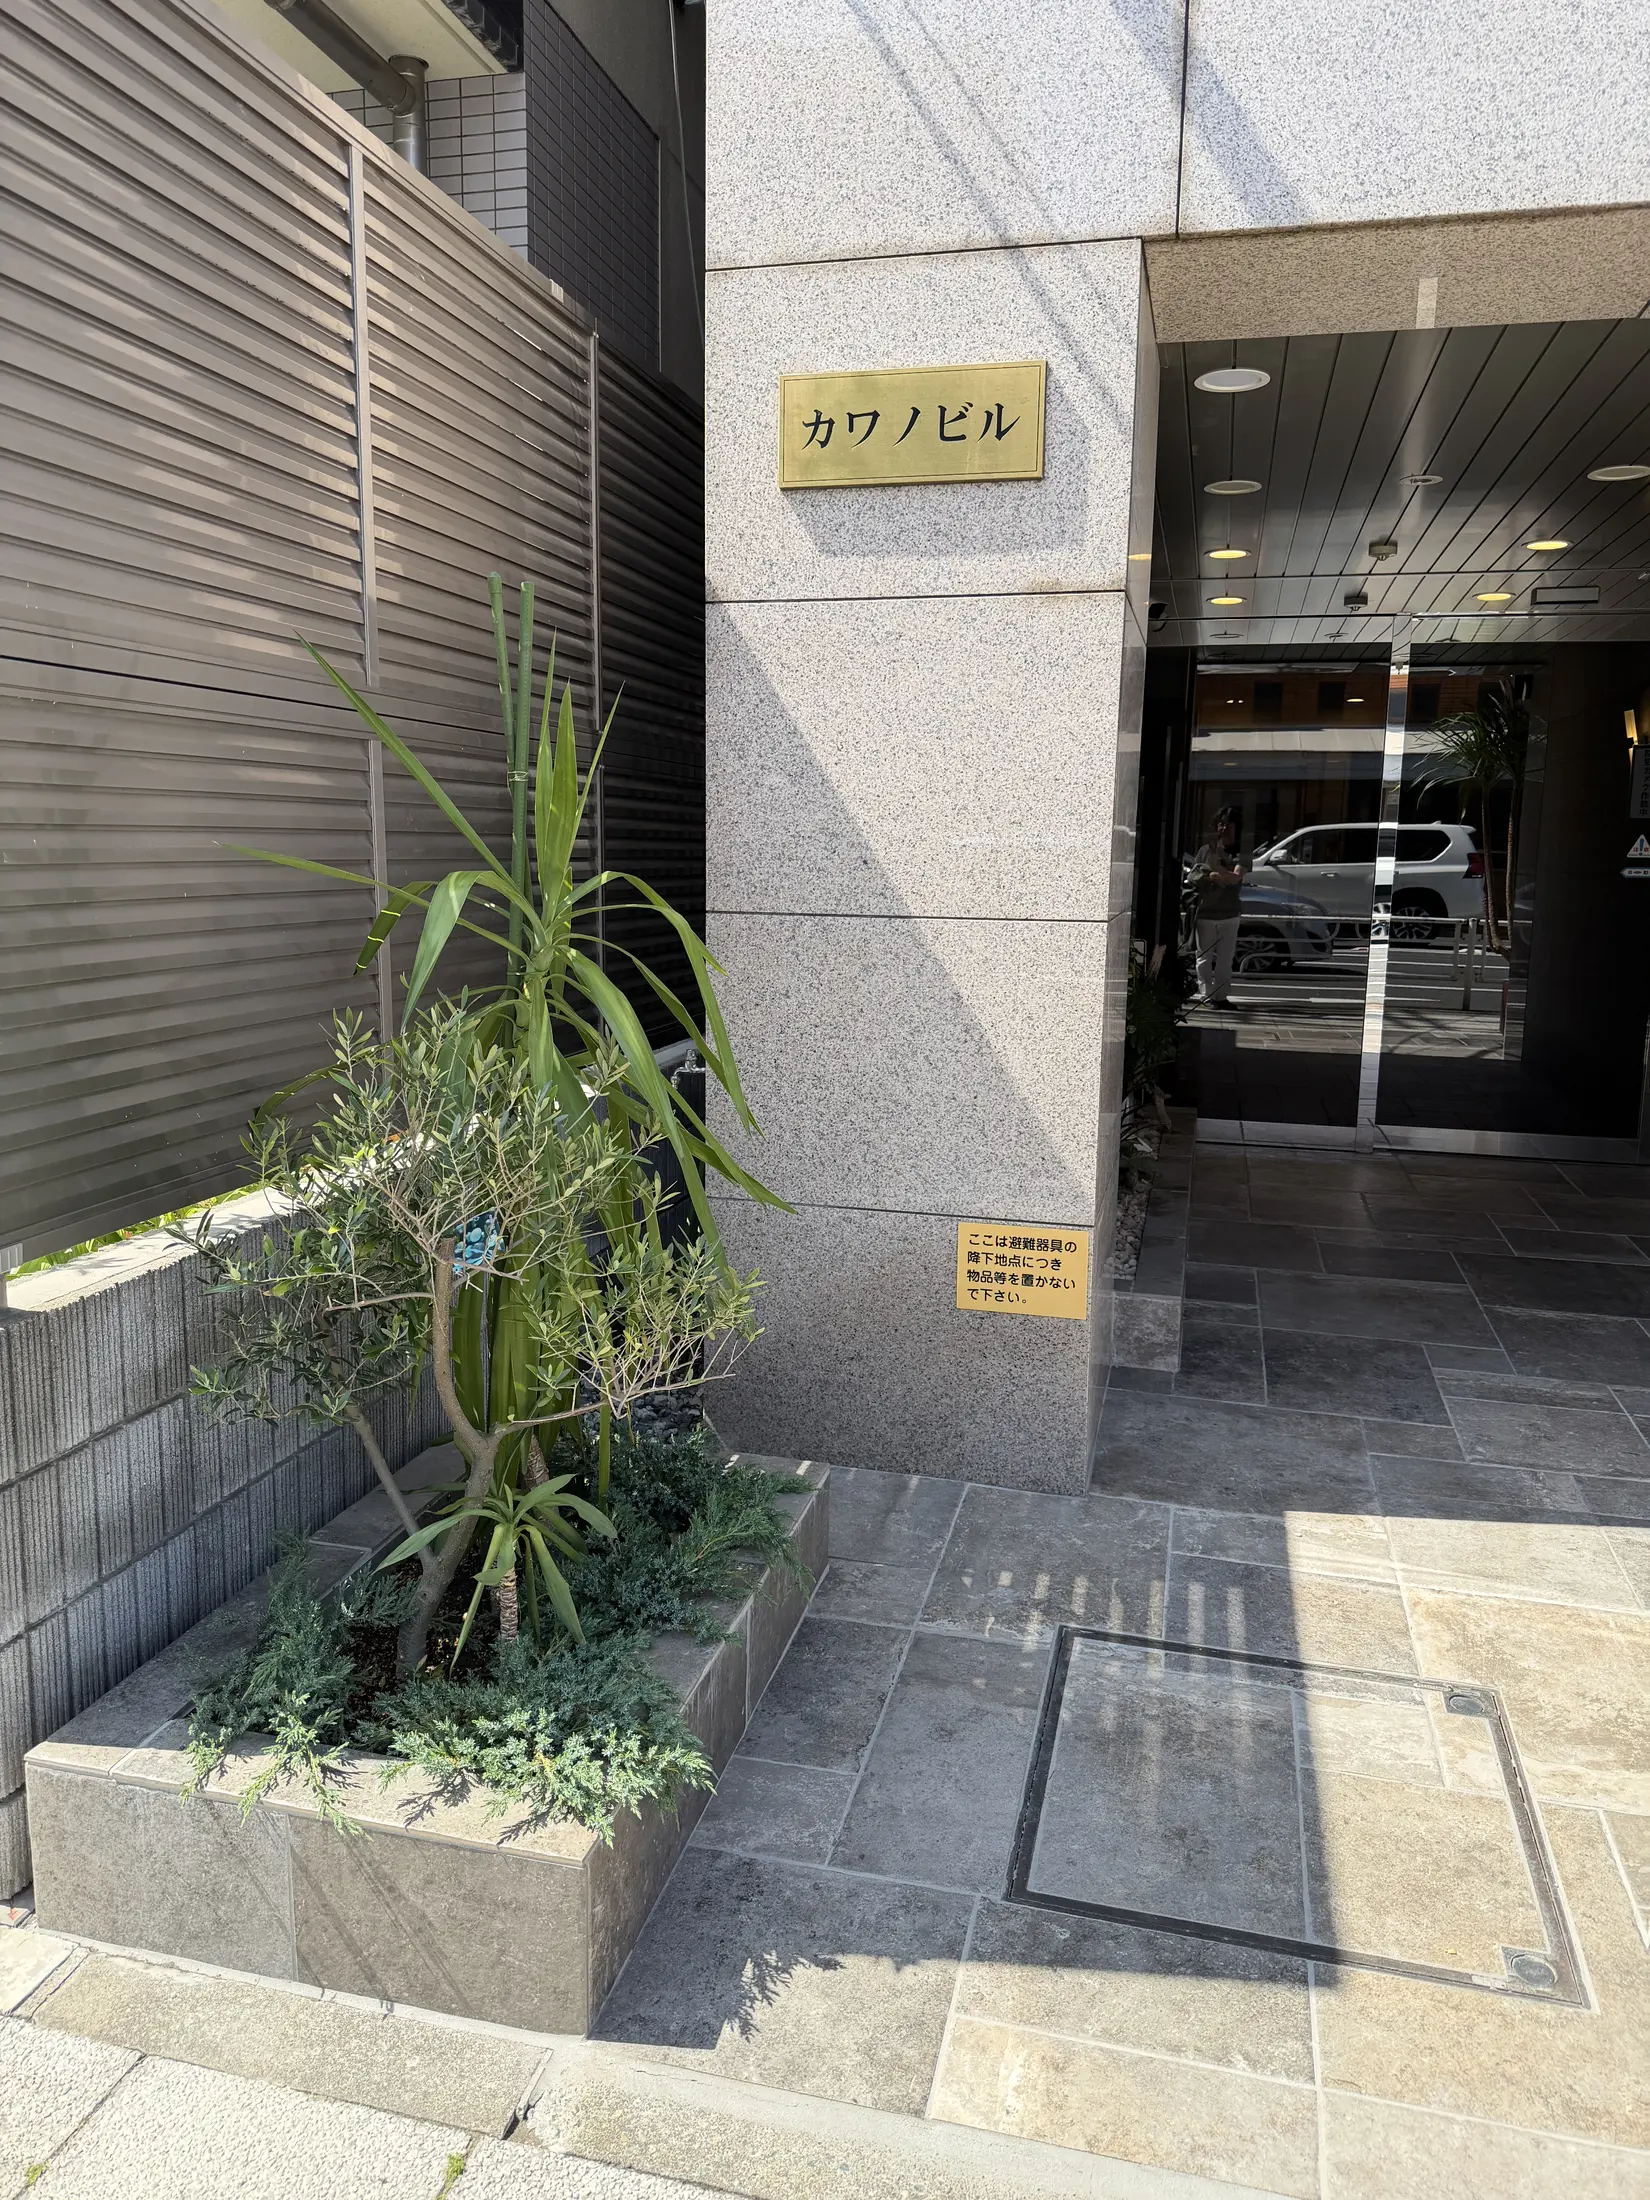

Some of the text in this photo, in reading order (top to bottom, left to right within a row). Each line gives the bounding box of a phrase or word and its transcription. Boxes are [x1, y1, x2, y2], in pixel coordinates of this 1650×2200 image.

[801, 401, 1021, 450] カワノビル
[969, 1233, 1077, 1254] ここは避難器具の
[967, 1251, 1062, 1271] 降下地点につき
[966, 1269, 1076, 1290] 物品等を置かない
[967, 1288, 1027, 1304] で下さい。
